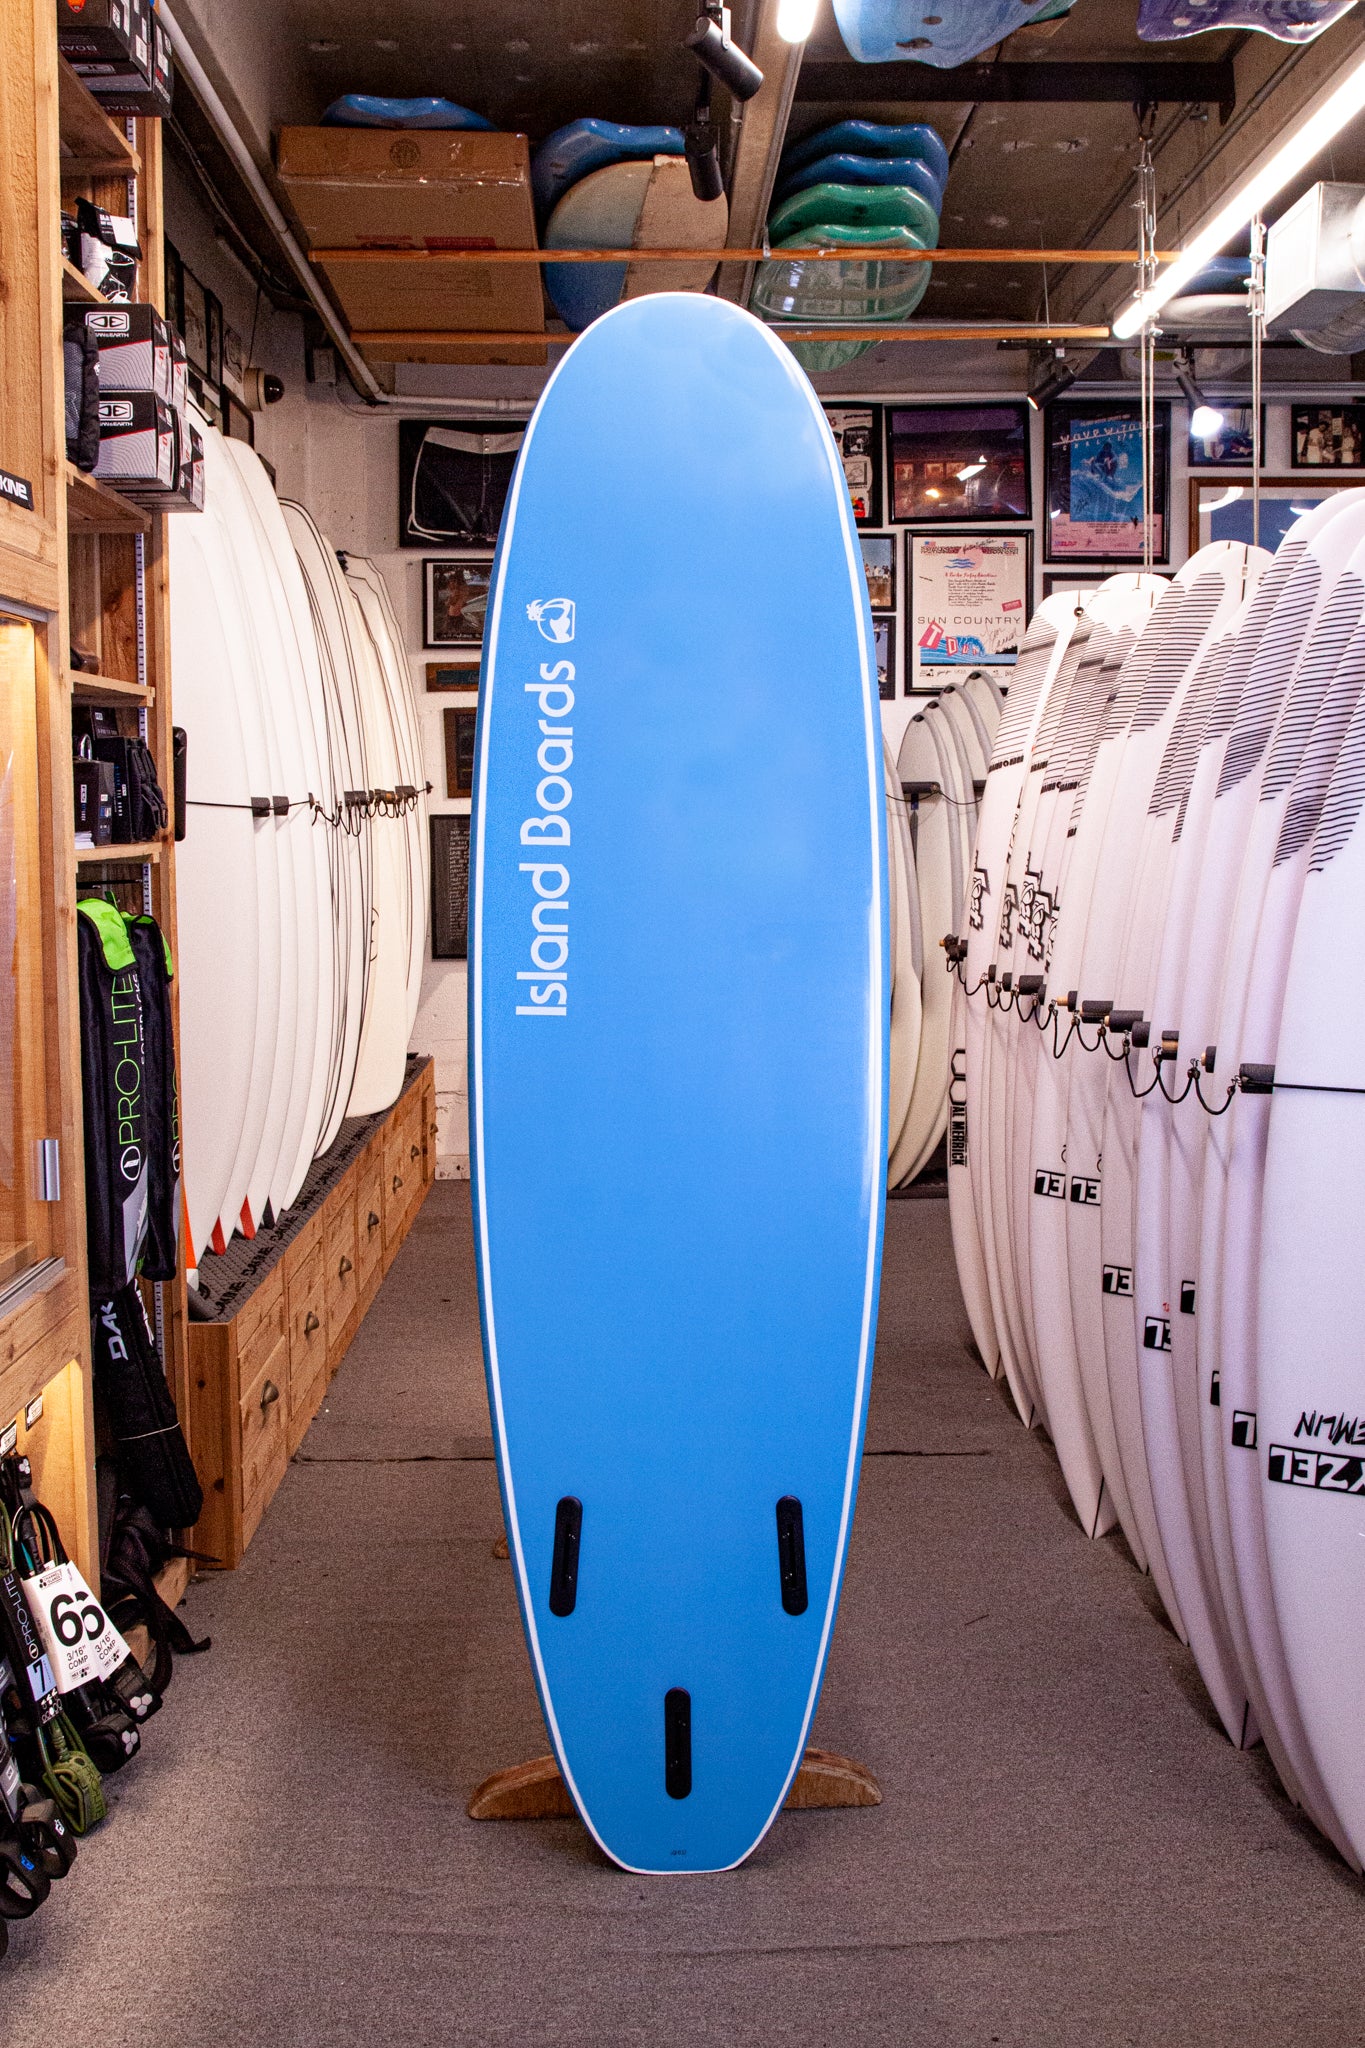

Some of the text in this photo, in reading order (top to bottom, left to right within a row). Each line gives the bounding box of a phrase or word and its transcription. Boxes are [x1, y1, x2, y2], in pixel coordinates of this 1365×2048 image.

[917, 615, 1021, 625] SUN COUNTRY
[519, 660, 576, 846] Boards
[515, 863, 570, 1016] Island
[111, 972, 142, 1146] PRO-LITE
[951, 1106, 965, 1166] AL MERRICK
[3, 1573, 36, 1647] PRO-LITE
[50, 1593, 84, 1648] 6
[33, 1659, 46, 1693] 7
[68, 1655, 89, 1670] COMP
[98, 1639, 117, 1661] COMP
